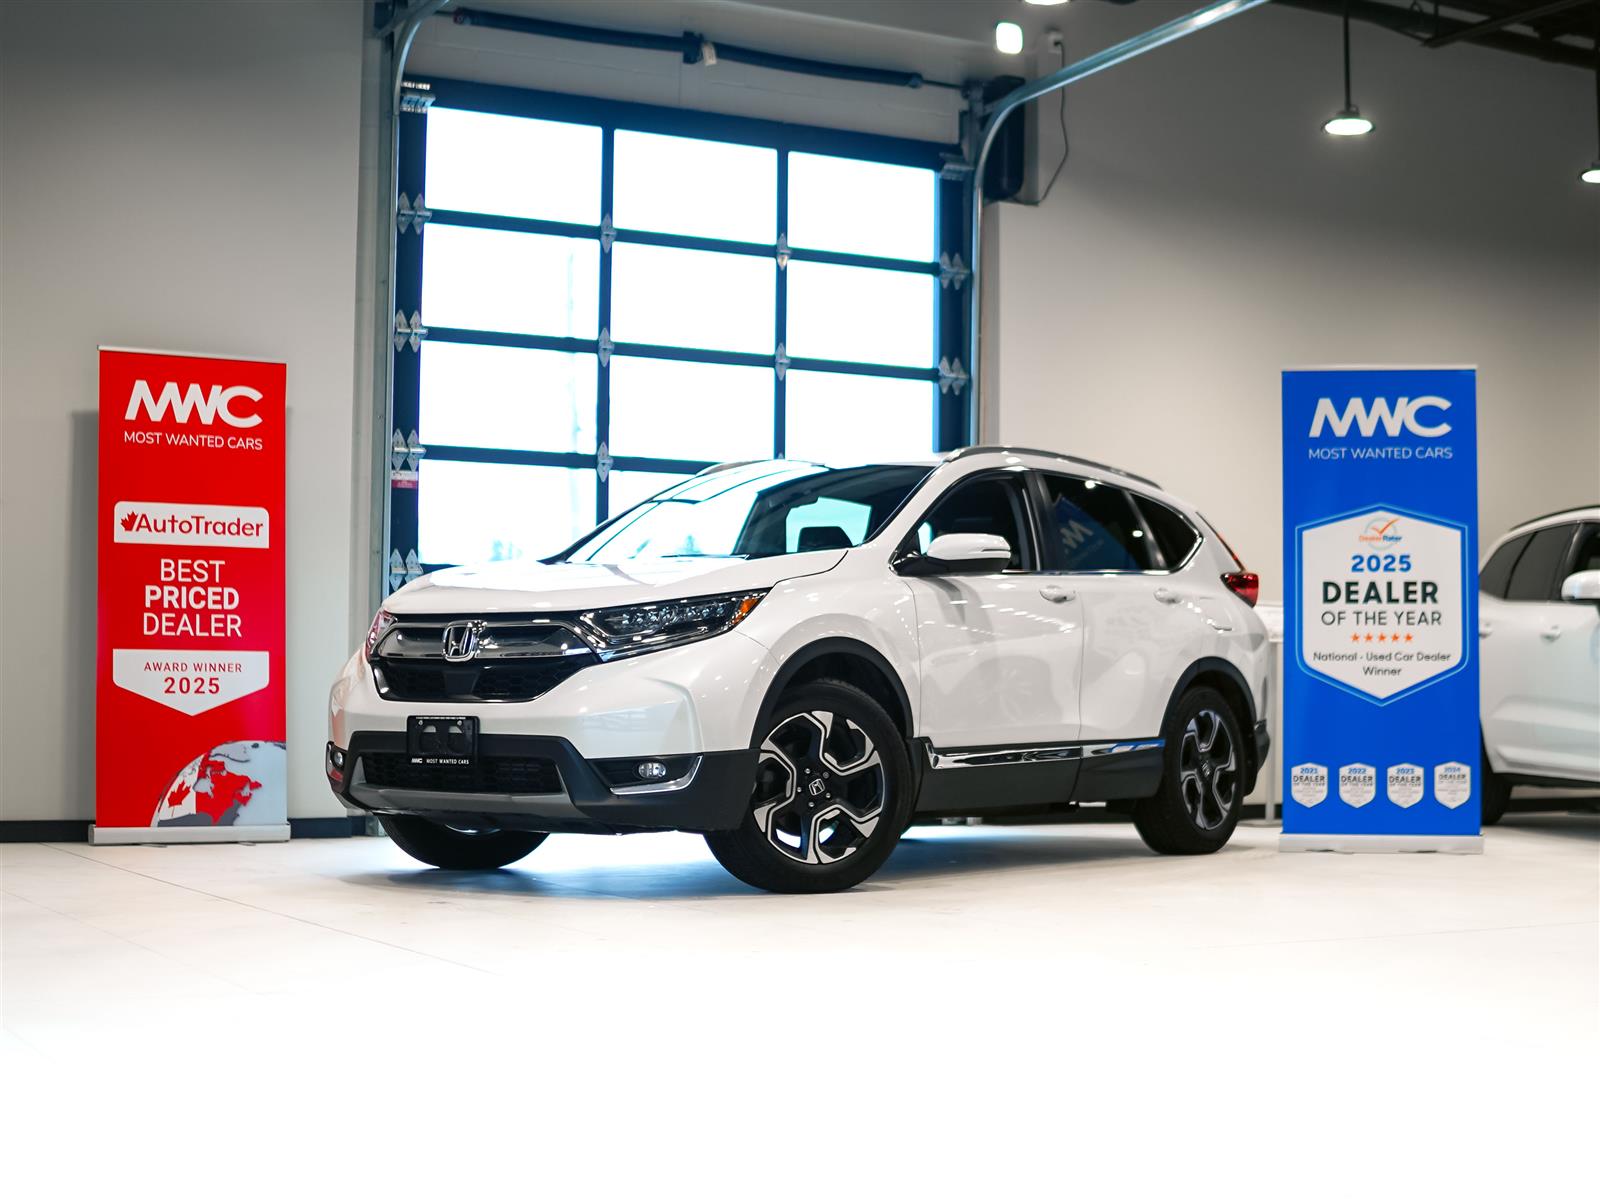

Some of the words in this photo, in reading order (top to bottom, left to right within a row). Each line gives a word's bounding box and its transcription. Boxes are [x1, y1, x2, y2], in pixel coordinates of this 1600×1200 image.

[124, 431, 162, 445] MOST
[166, 433, 225, 449] WANTED
[227, 436, 263, 450] CARS
[1308, 447, 1347, 460] MOST
[1351, 447, 1412, 459] WANTED
[1415, 447, 1453, 459] CARS
[135, 513, 263, 537] AutoTrader
[160, 558, 226, 583] BEST
[1351, 554, 1412, 573] 2025
[144, 585, 240, 610] PRICED
[1322, 581, 1439, 605] DEALER
[143, 612, 243, 638] DEALER
[1321, 611, 1346, 626] OF
[1353, 611, 1388, 626] THE
[1394, 611, 1442, 626] YEAR
[1313, 652, 1358, 663] National
[1366, 652, 1392, 663] Used
[1394, 652, 1414, 663] Car
[1416, 652, 1451, 663] Dealer
[143, 661, 188, 673] AWARD
[193, 662, 243, 673] WINNER
[1362, 666, 1402, 676] Winner
[164, 677, 221, 695] 2025
[1292, 775, 1325, 783] DEALER
[1340, 775, 1373, 783] DEALER
[1388, 775, 1421, 783] DEALER
